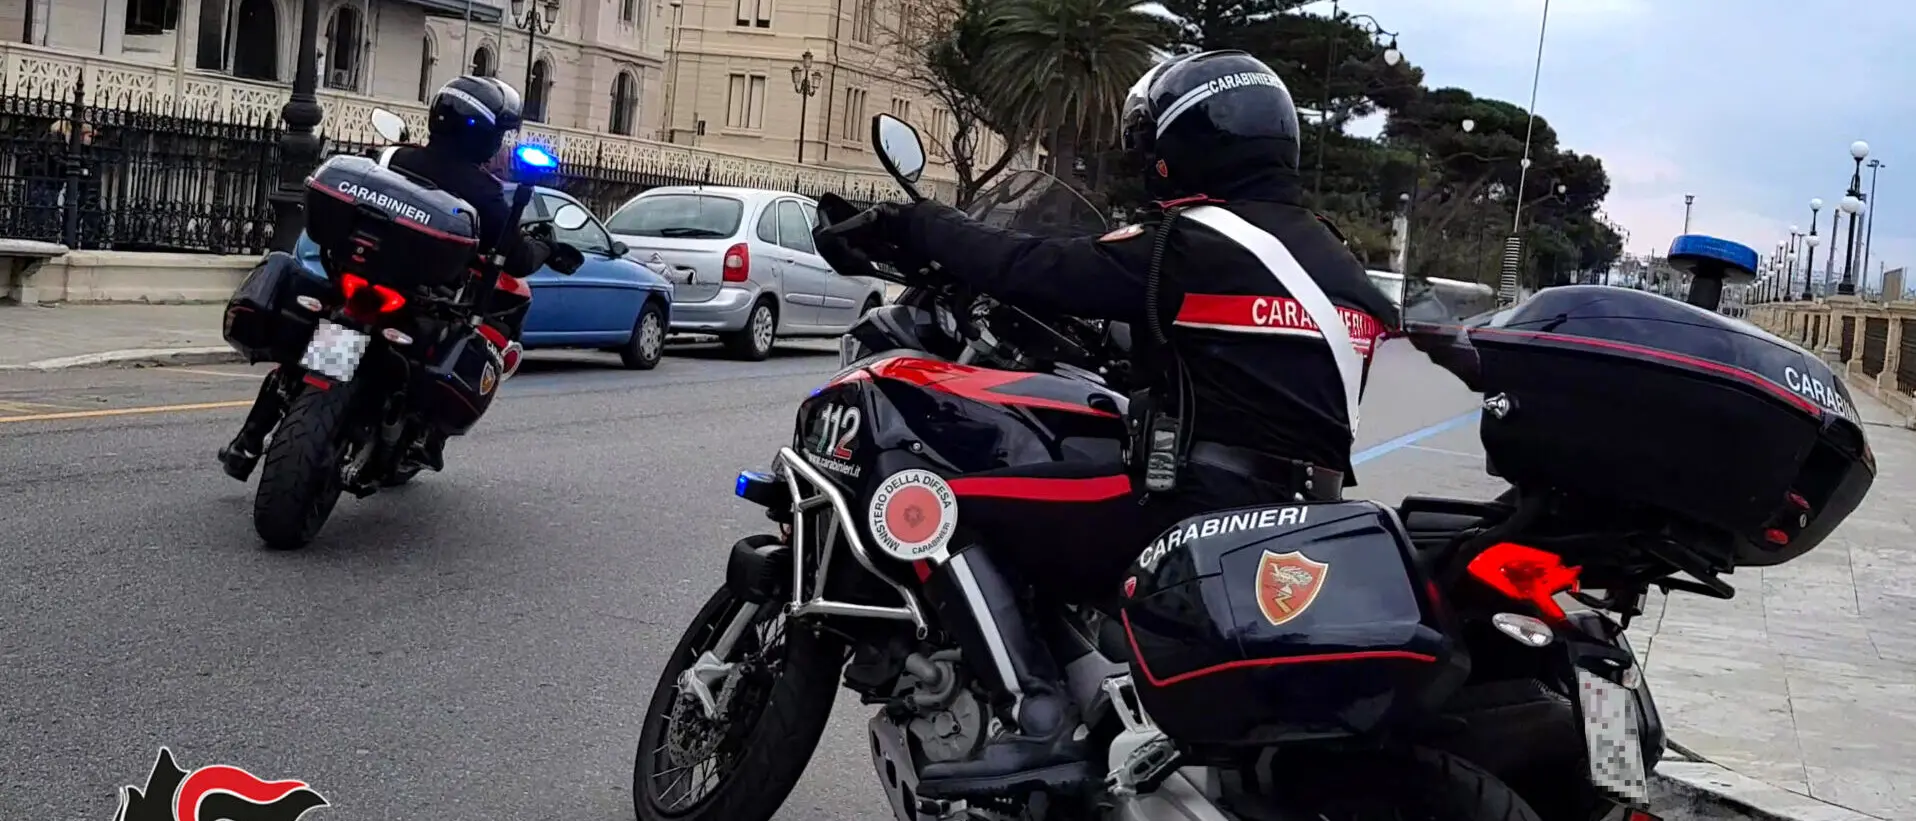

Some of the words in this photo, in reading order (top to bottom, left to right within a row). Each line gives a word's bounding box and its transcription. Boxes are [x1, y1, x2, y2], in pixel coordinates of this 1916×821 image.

[1209, 72, 1283, 94] CARABINIE
[338, 181, 431, 225] CARABINIERI
[1252, 298, 1365, 337] CARAIERI
[816, 403, 861, 460] 112
[886, 474, 920, 495] DELLA
[923, 475, 951, 509] DIFESA
[874, 495, 900, 552] MINISTERO
[912, 522, 950, 555] CARABINIERI
[1139, 506, 1308, 568] CARABINIERI
